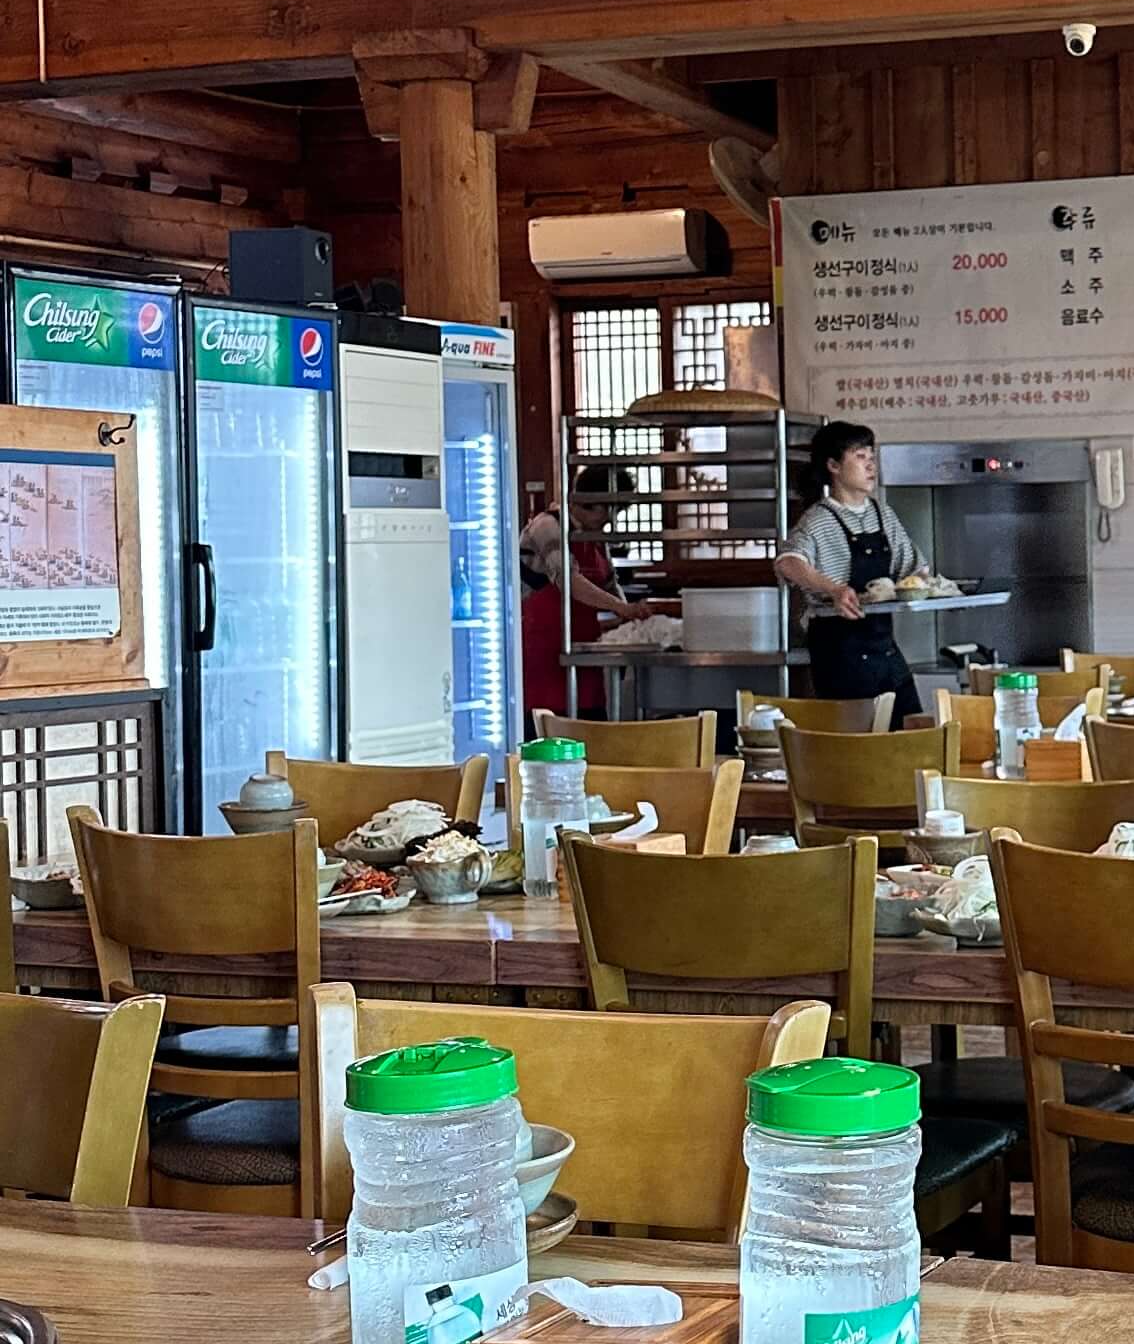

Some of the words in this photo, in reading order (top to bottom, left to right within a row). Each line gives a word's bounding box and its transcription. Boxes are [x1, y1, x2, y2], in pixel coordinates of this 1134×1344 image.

[952, 252, 1008, 271] 20,000
[23, 292, 100, 340] Chilsung
[954, 307, 1008, 326] 15,000
[1061, 307, 1104, 326] 음료수
[46, 327, 83, 343] Cider
[201, 319, 268, 363] Chilsung
[141, 347, 163, 359] pepsi
[473, 340, 497, 357] FINE
